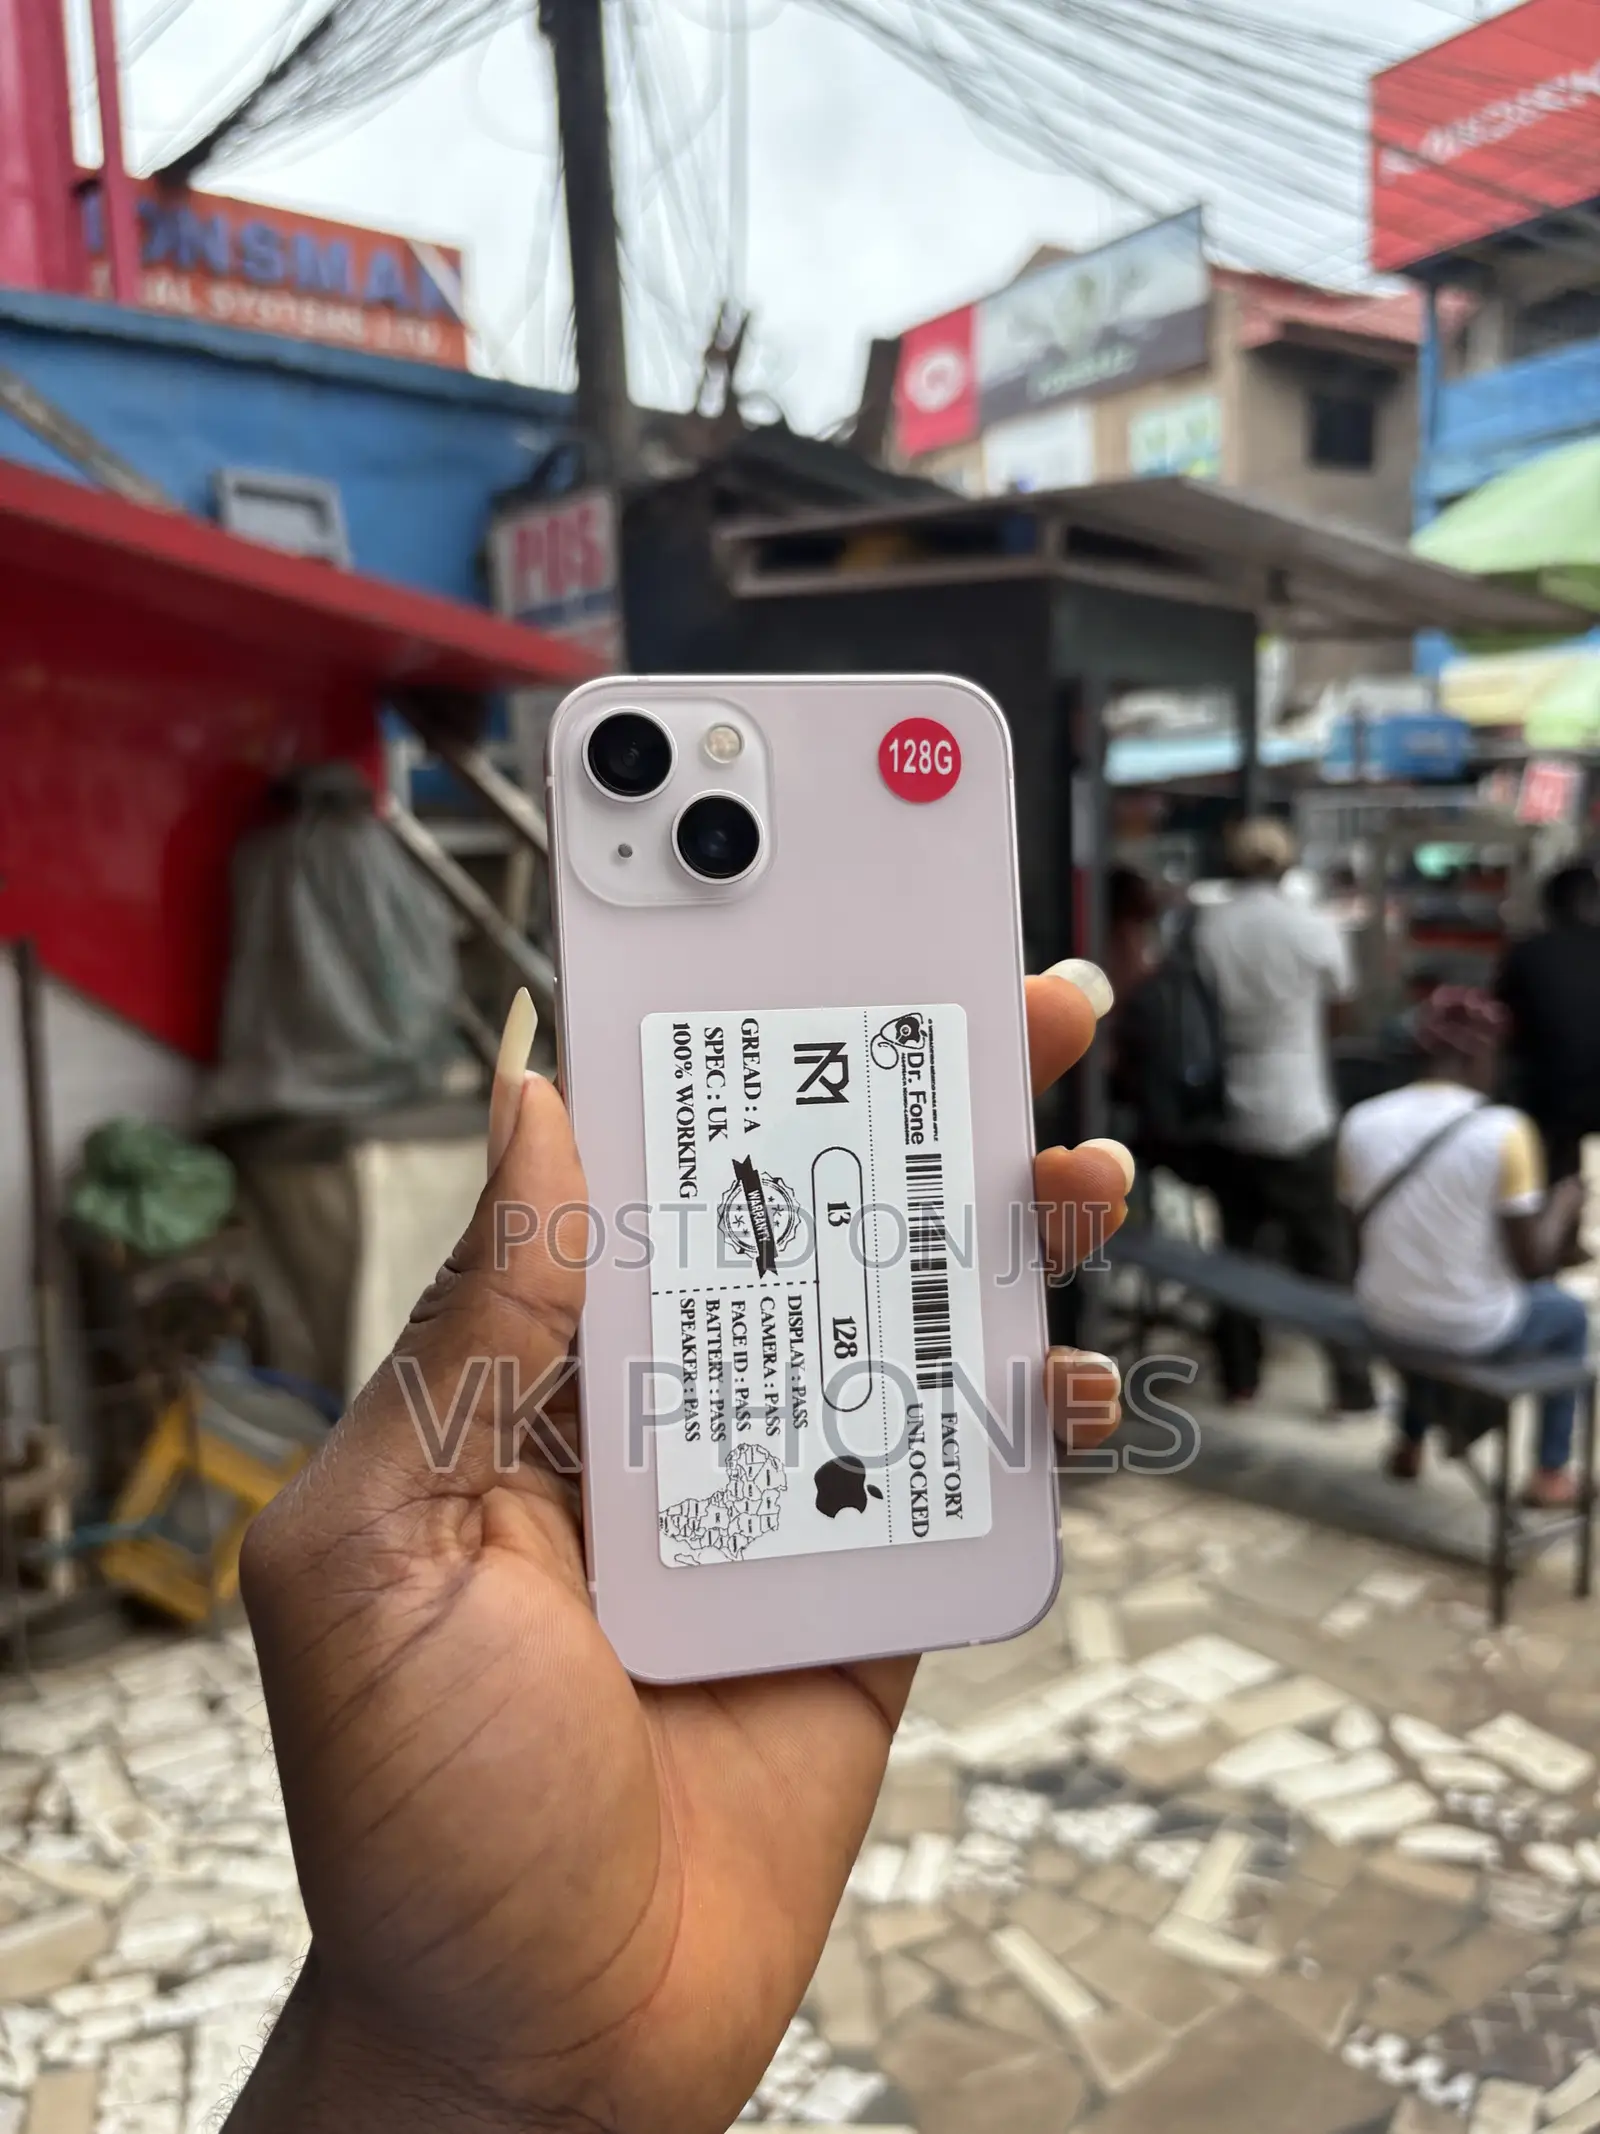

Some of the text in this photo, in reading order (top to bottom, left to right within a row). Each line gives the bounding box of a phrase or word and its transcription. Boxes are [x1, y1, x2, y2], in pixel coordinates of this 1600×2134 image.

[888, 737, 954, 776] 128G
[704, 1026, 726, 1089] SPEC
[740, 1017, 762, 1100] GREAD
[672, 1022, 698, 1199] 100% WORKING
[906, 1052, 928, 1145] Dr. Fone
[707, 1105, 728, 1142] UK
[743, 1118, 761, 1134] A
[748, 1189, 771, 1242] WARRANTY
[827, 1201, 852, 1227] 13
[679, 1298, 698, 1385] SPEAKER
[705, 1299, 724, 1384] BATTERY
[731, 1300, 748, 1347] FACE
[759, 1295, 777, 1381] CAMERA
[787, 1295, 805, 1369] DISPLAY
[832, 1315, 858, 1360] 128
[733, 1350, 749, 1373] ID
[683, 1398, 701, 1442] PASS
[709, 1398, 727, 1443] PASS
[735, 1387, 752, 1432] PASS
[764, 1392, 781, 1437] PASS
[791, 1385, 809, 1430] PASS
[906, 1403, 930, 1538] UNLOCKED
[941, 1412, 963, 1520] FACTORY
